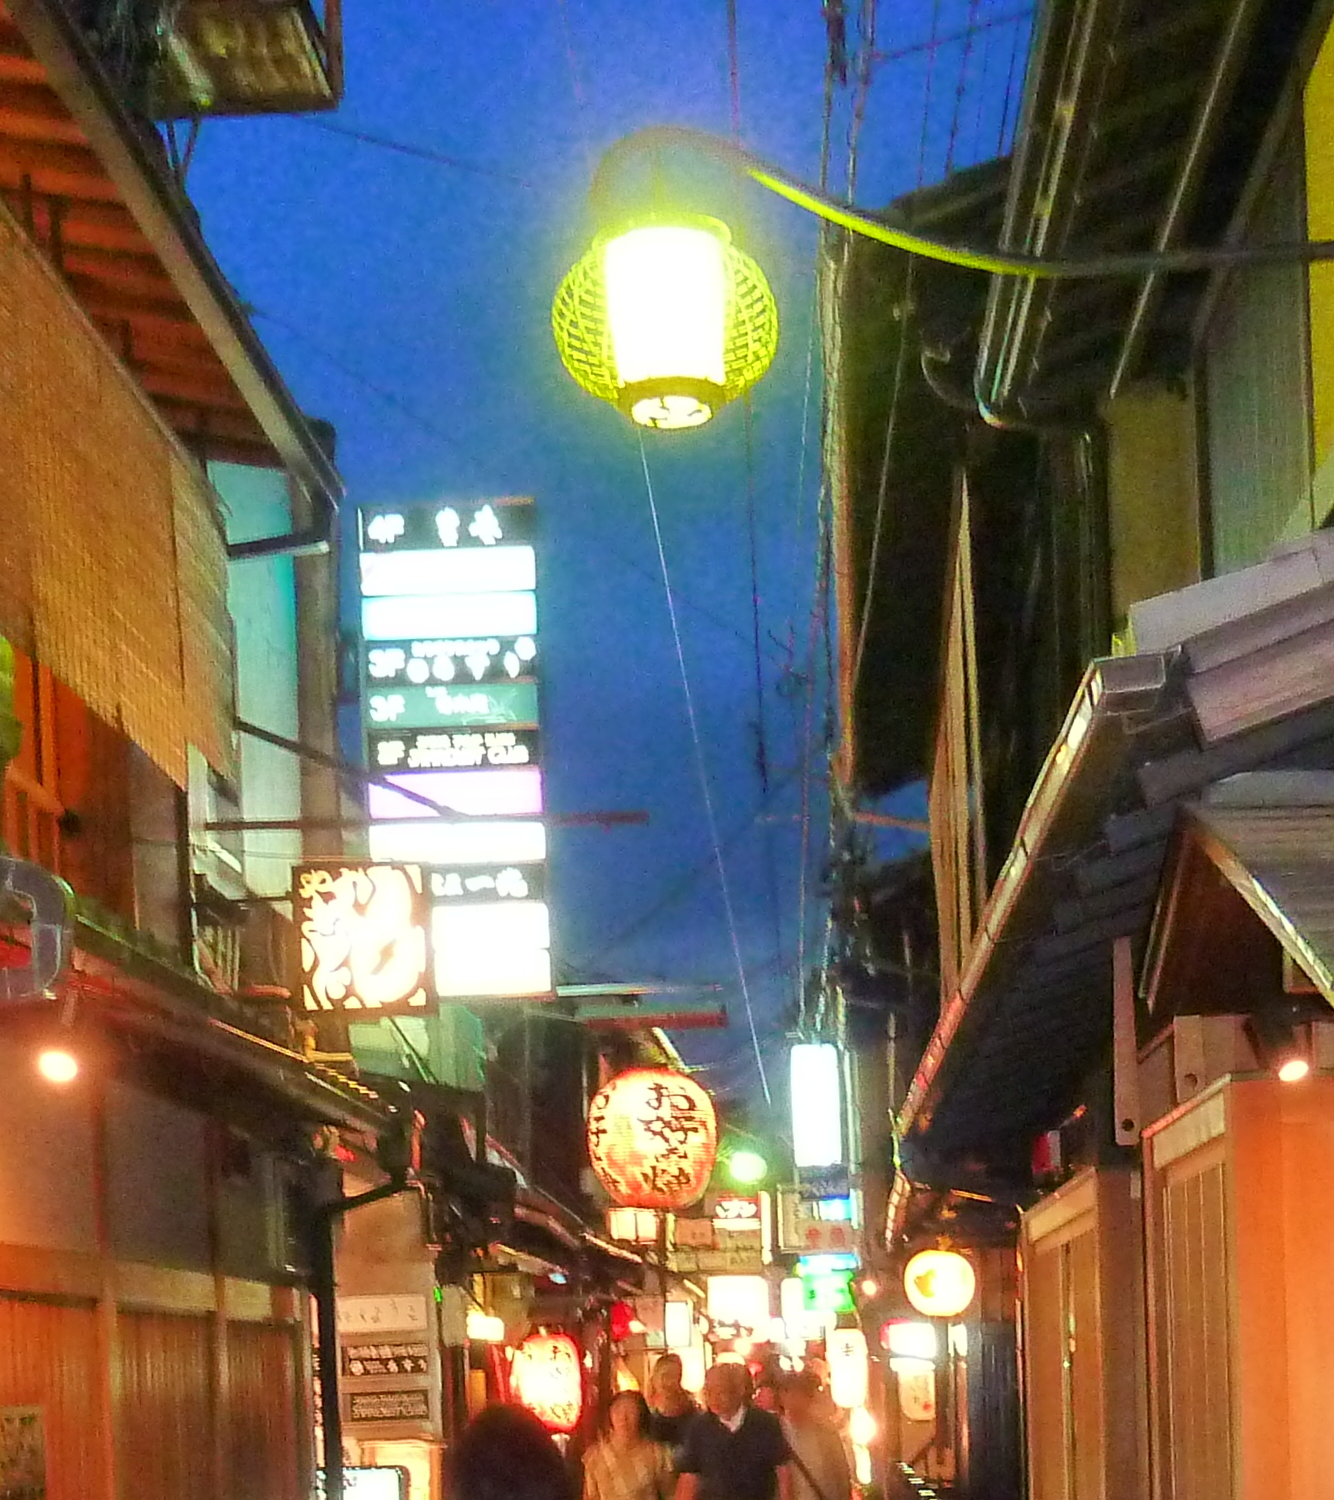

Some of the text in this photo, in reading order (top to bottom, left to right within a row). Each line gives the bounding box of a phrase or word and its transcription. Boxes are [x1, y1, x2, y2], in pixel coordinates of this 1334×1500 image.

[368, 514, 405, 544] 4F
[369, 648, 406, 678] 3F
[369, 694, 406, 722] 3F
